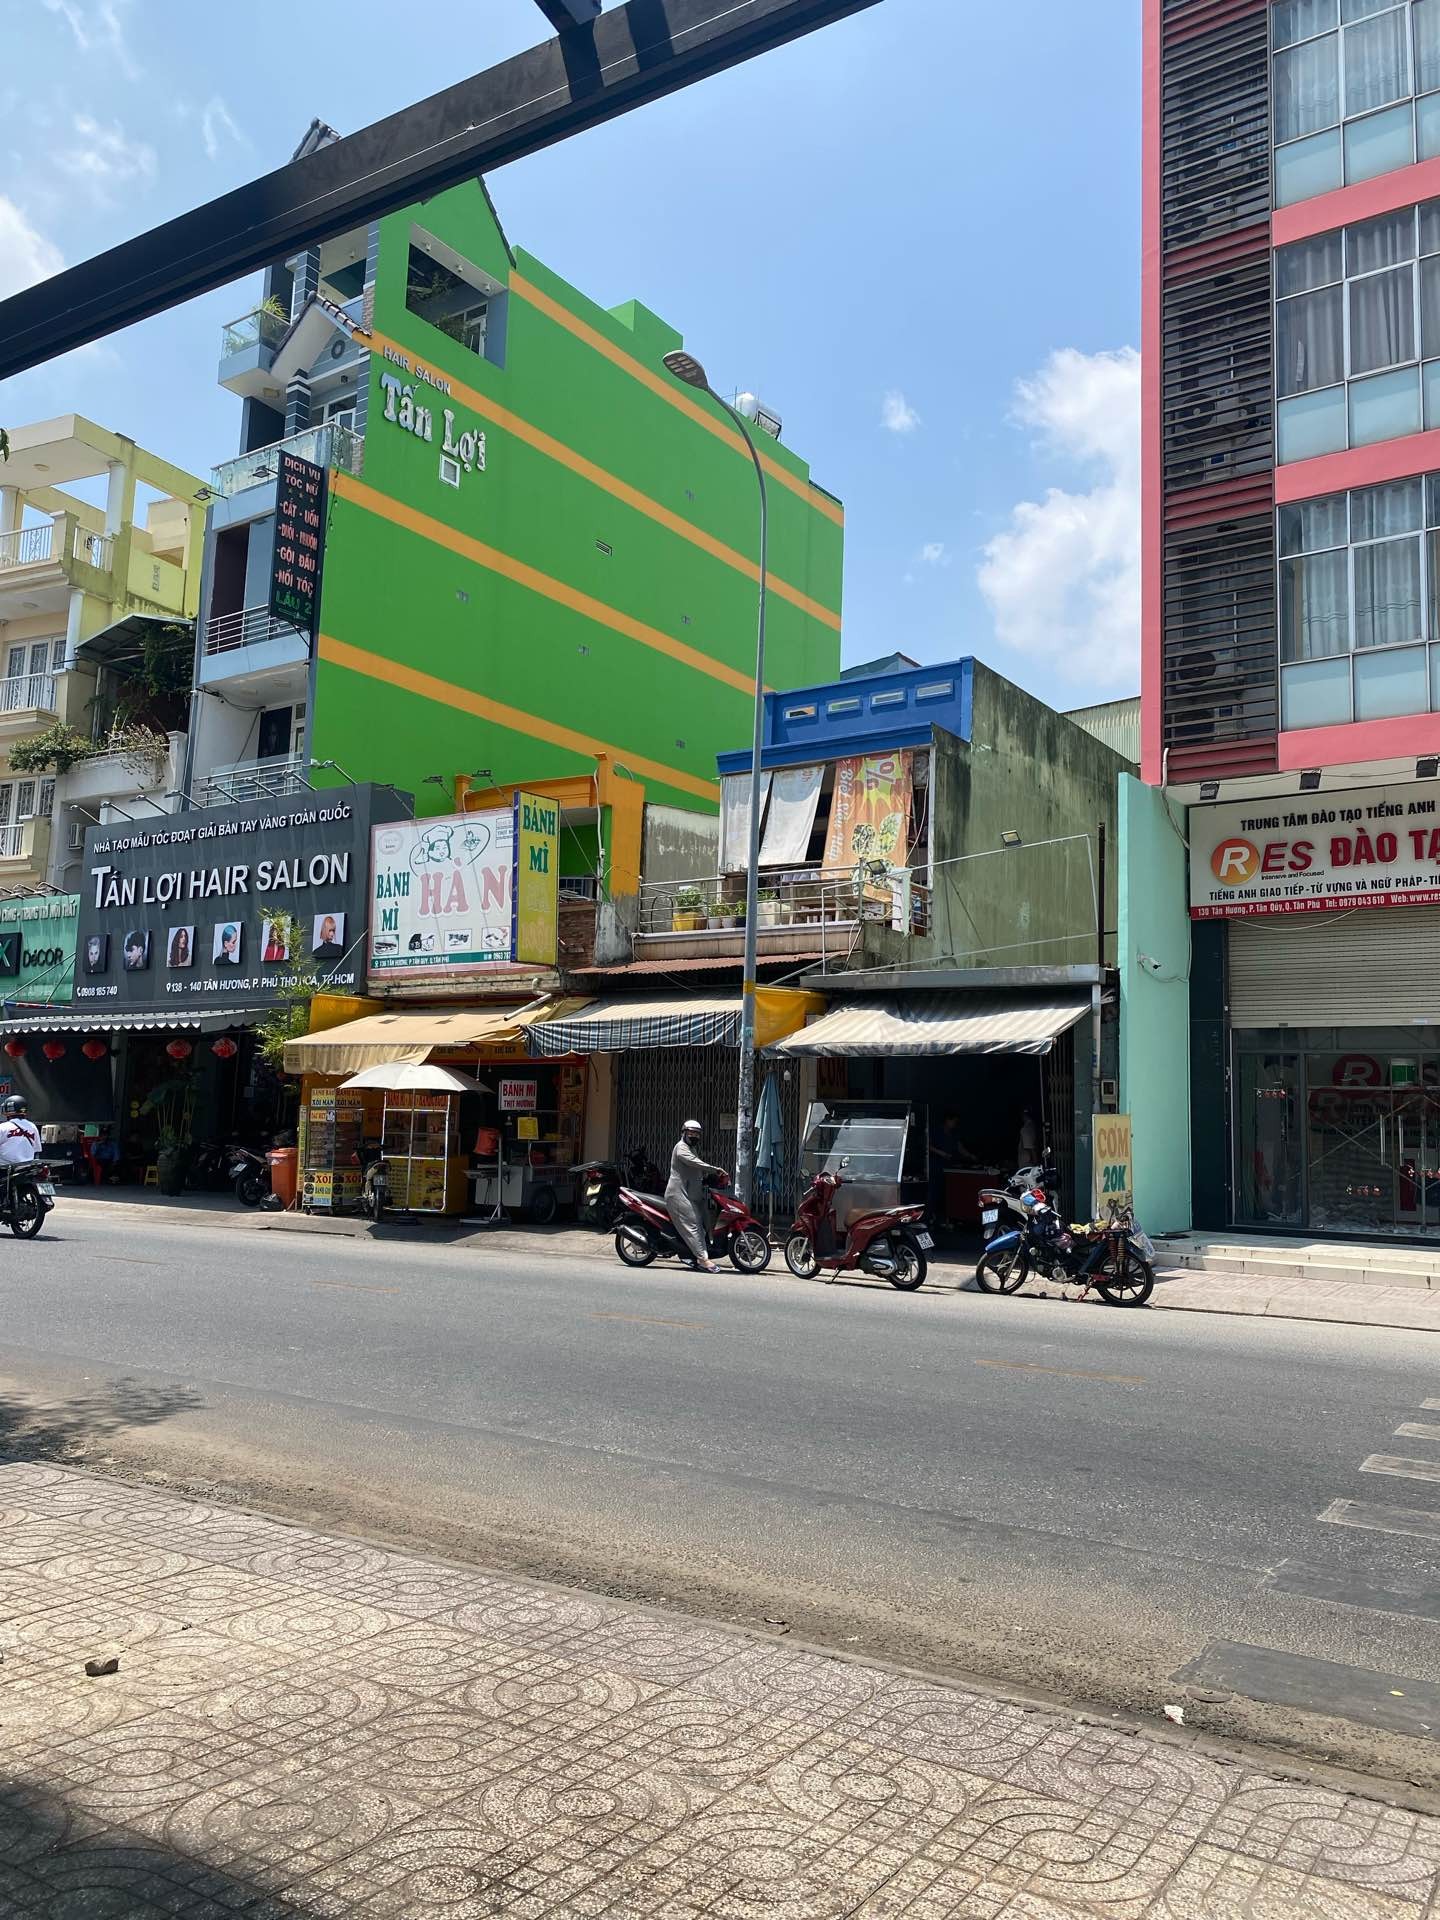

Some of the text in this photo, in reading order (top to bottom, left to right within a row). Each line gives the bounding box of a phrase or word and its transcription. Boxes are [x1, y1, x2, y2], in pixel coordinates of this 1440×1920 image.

[384, 345, 451, 396] HAIR SALON
[381, 372, 486, 473] Tấn Lợi
[284, 457, 320, 481] DỊCH VỤ
[285, 473, 303, 489] TÓC
[304, 602, 312, 614] 2
[93, 800, 351, 853] NHÀ TẠO MẪU TÓC ĐOẠT GIẢI BÀN TAY VÀNG TOÀN QUỐC
[522, 801, 556, 836] BÁNH
[1241, 800, 1436, 831] TRUNG TÂM ĐÀO TẠO TIẾNG ANH
[529, 841, 550, 873] MÌ
[1216, 840, 1315, 877] RES
[1330, 826, 1399, 867] ĐÀO
[91, 852, 349, 909] TẤN LỢI HAIR SALON
[376, 866, 410, 899] BÁNH
[419, 856, 470, 916] HÀ
[1209, 888, 1235, 901] TIẾNG
[1238, 887, 1257, 899] ANH
[1260, 887, 1282, 898] GIAO
[1326, 881, 1352, 894] VỰNG
[1355, 878, 1368, 891] VÀ
[1371, 876, 1392, 889] NGỮ
[382, 901, 400, 931] MÌ
[1212, 906, 1223, 915] Tân
[1307, 900, 1320, 909] Phú
[1325, 898, 1338, 908] Tel:
[1391, 893, 1409, 903] Web:
[189, 981, 201, 992] 140
[203, 978, 218, 991] TÂN
[220, 978, 251, 991] HƯƠNG,
[252, 978, 259, 988] P.
[261, 975, 278, 988] PHÚ
[321, 973, 354, 986] TP.HCM
[502, 1080, 525, 1097] BÁNH
[1097, 1120, 1129, 1158] CƠM
[1102, 1165, 1127, 1193] 20K
